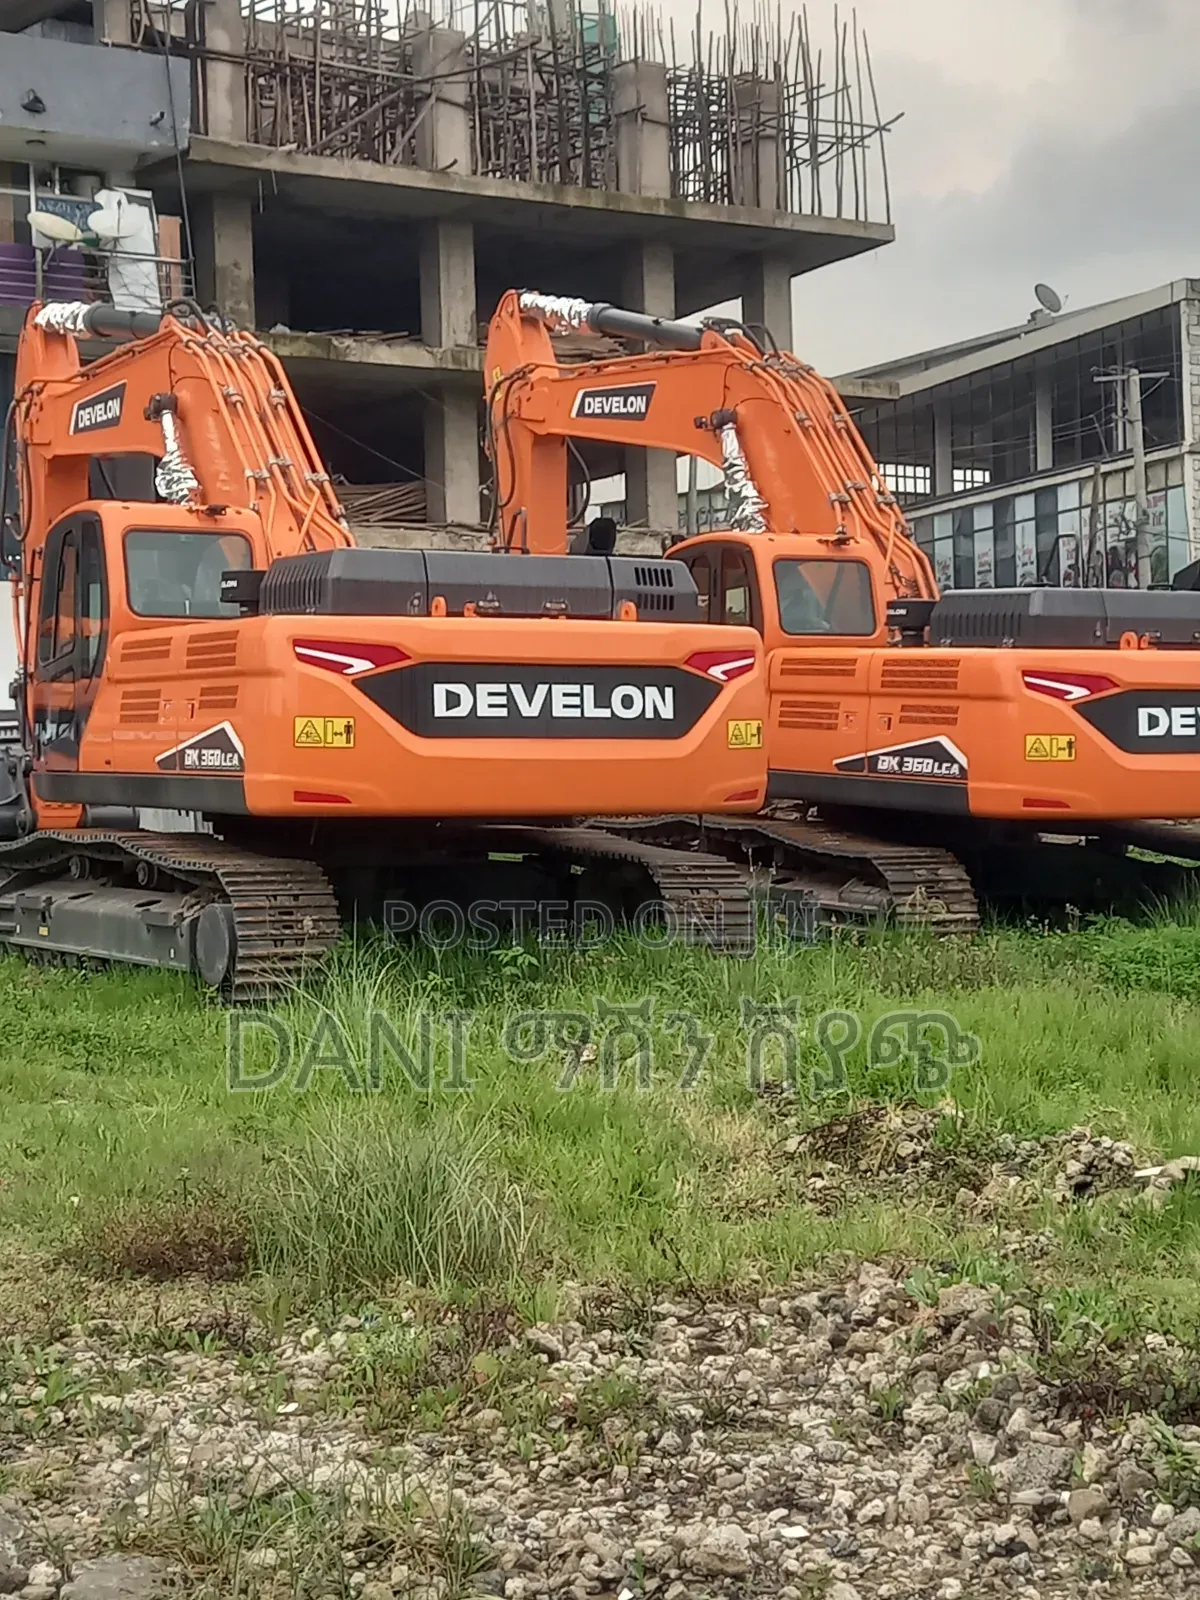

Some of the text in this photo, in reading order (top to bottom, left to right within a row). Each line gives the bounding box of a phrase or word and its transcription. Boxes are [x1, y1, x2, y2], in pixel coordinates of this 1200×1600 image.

[78, 397, 121, 428] DEVELON
[583, 395, 647, 414] DEVELON
[433, 683, 674, 719] DEVELON
[1137, 707, 1200, 736] DE
